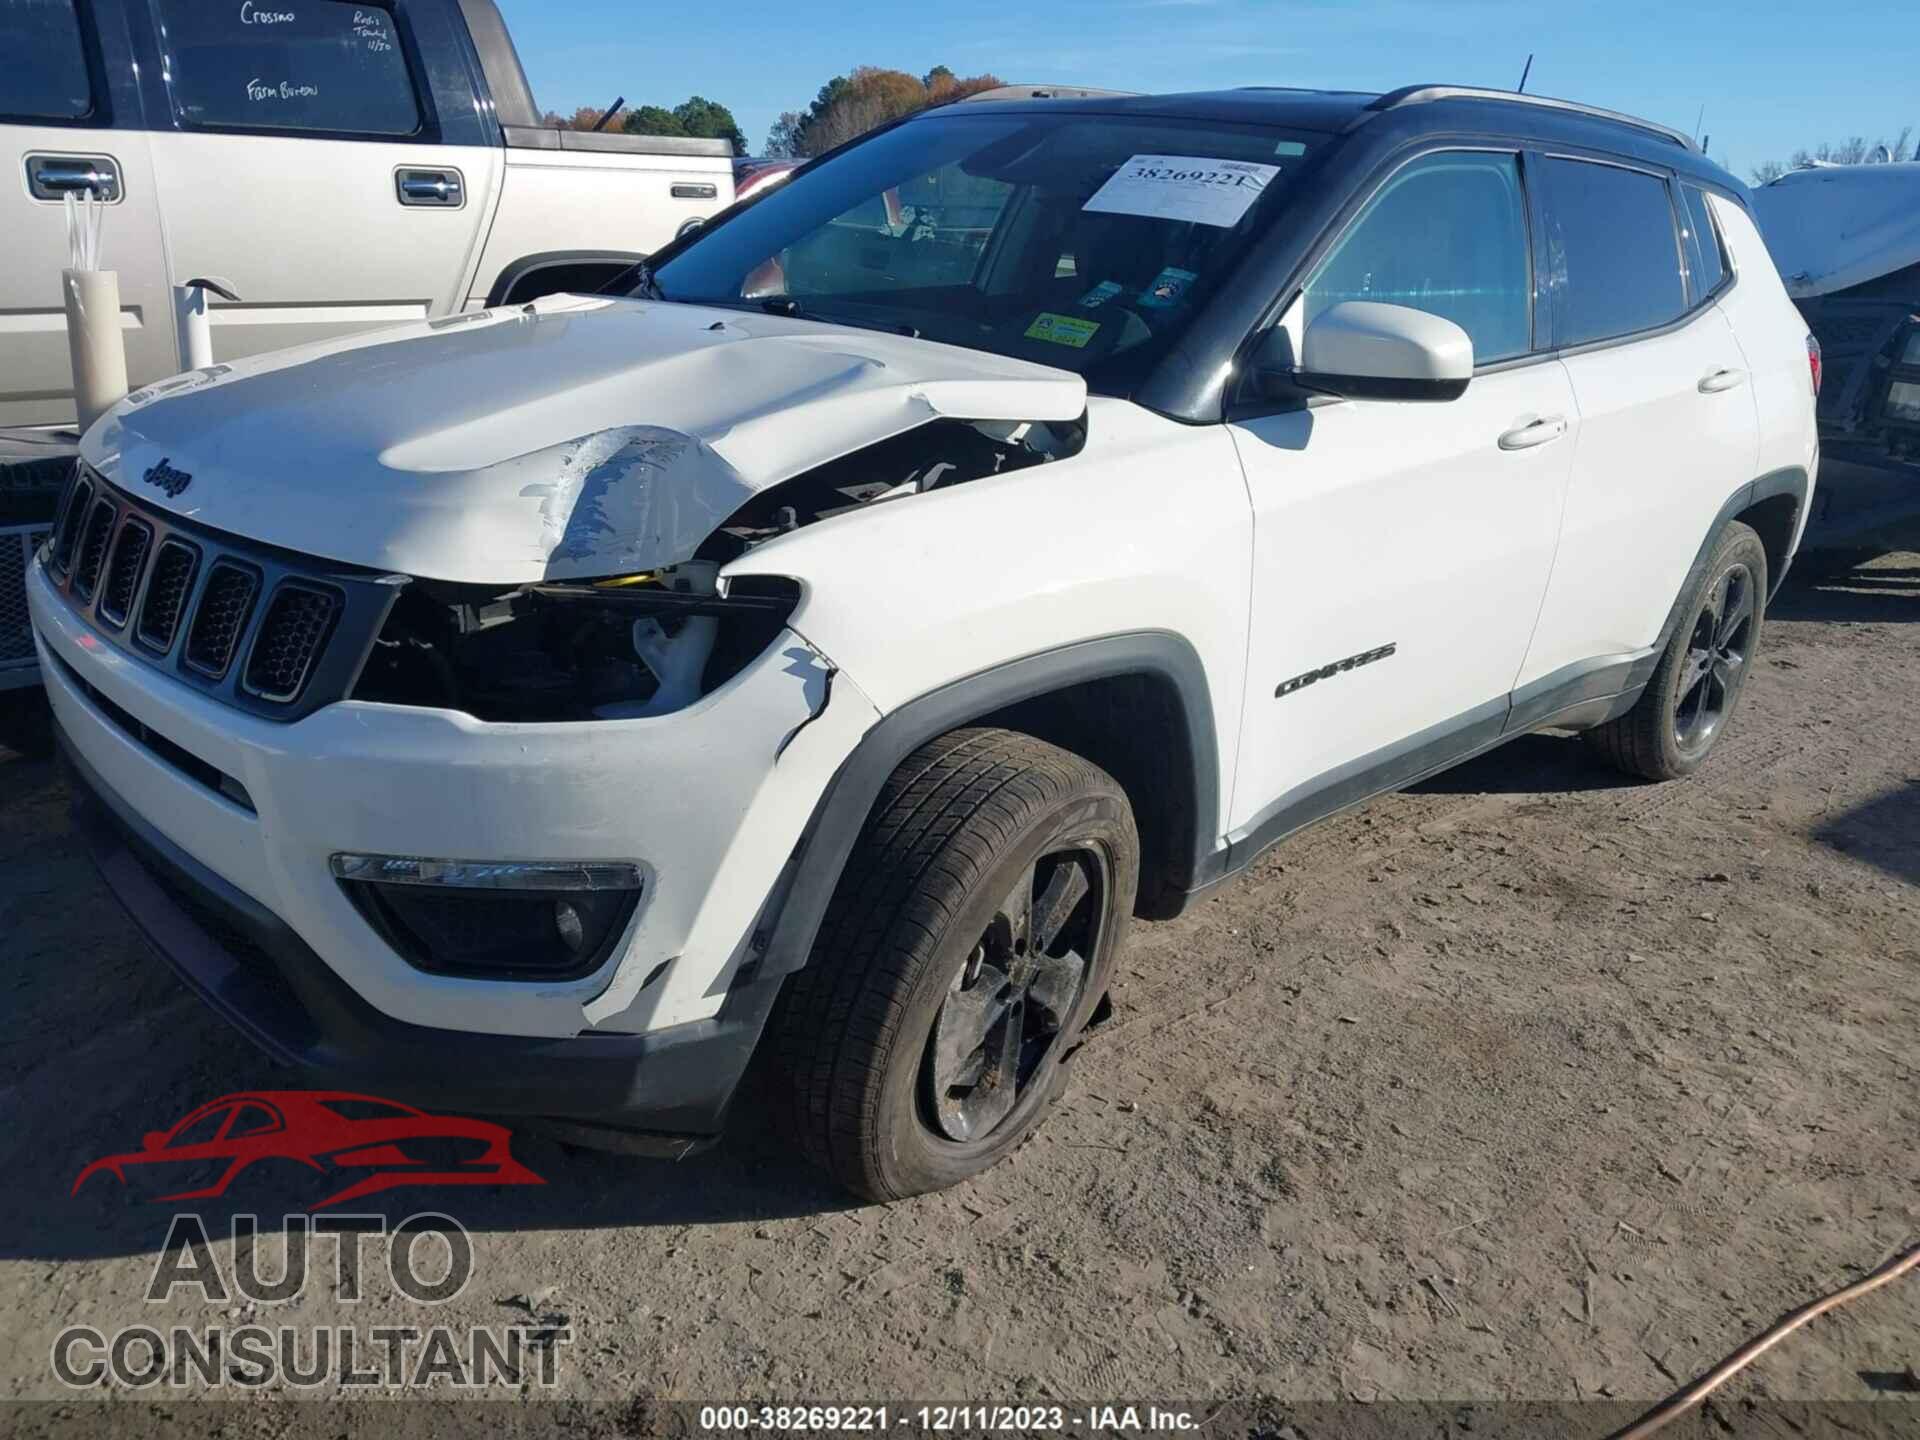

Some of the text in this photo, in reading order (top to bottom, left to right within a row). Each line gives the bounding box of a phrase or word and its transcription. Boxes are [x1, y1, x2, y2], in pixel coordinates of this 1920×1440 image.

[247, 78, 277, 101] Farm
[1128, 167, 1246, 187] 38269221
[143, 457, 192, 498] Jeep
[1275, 642, 1396, 698] COMPASS
